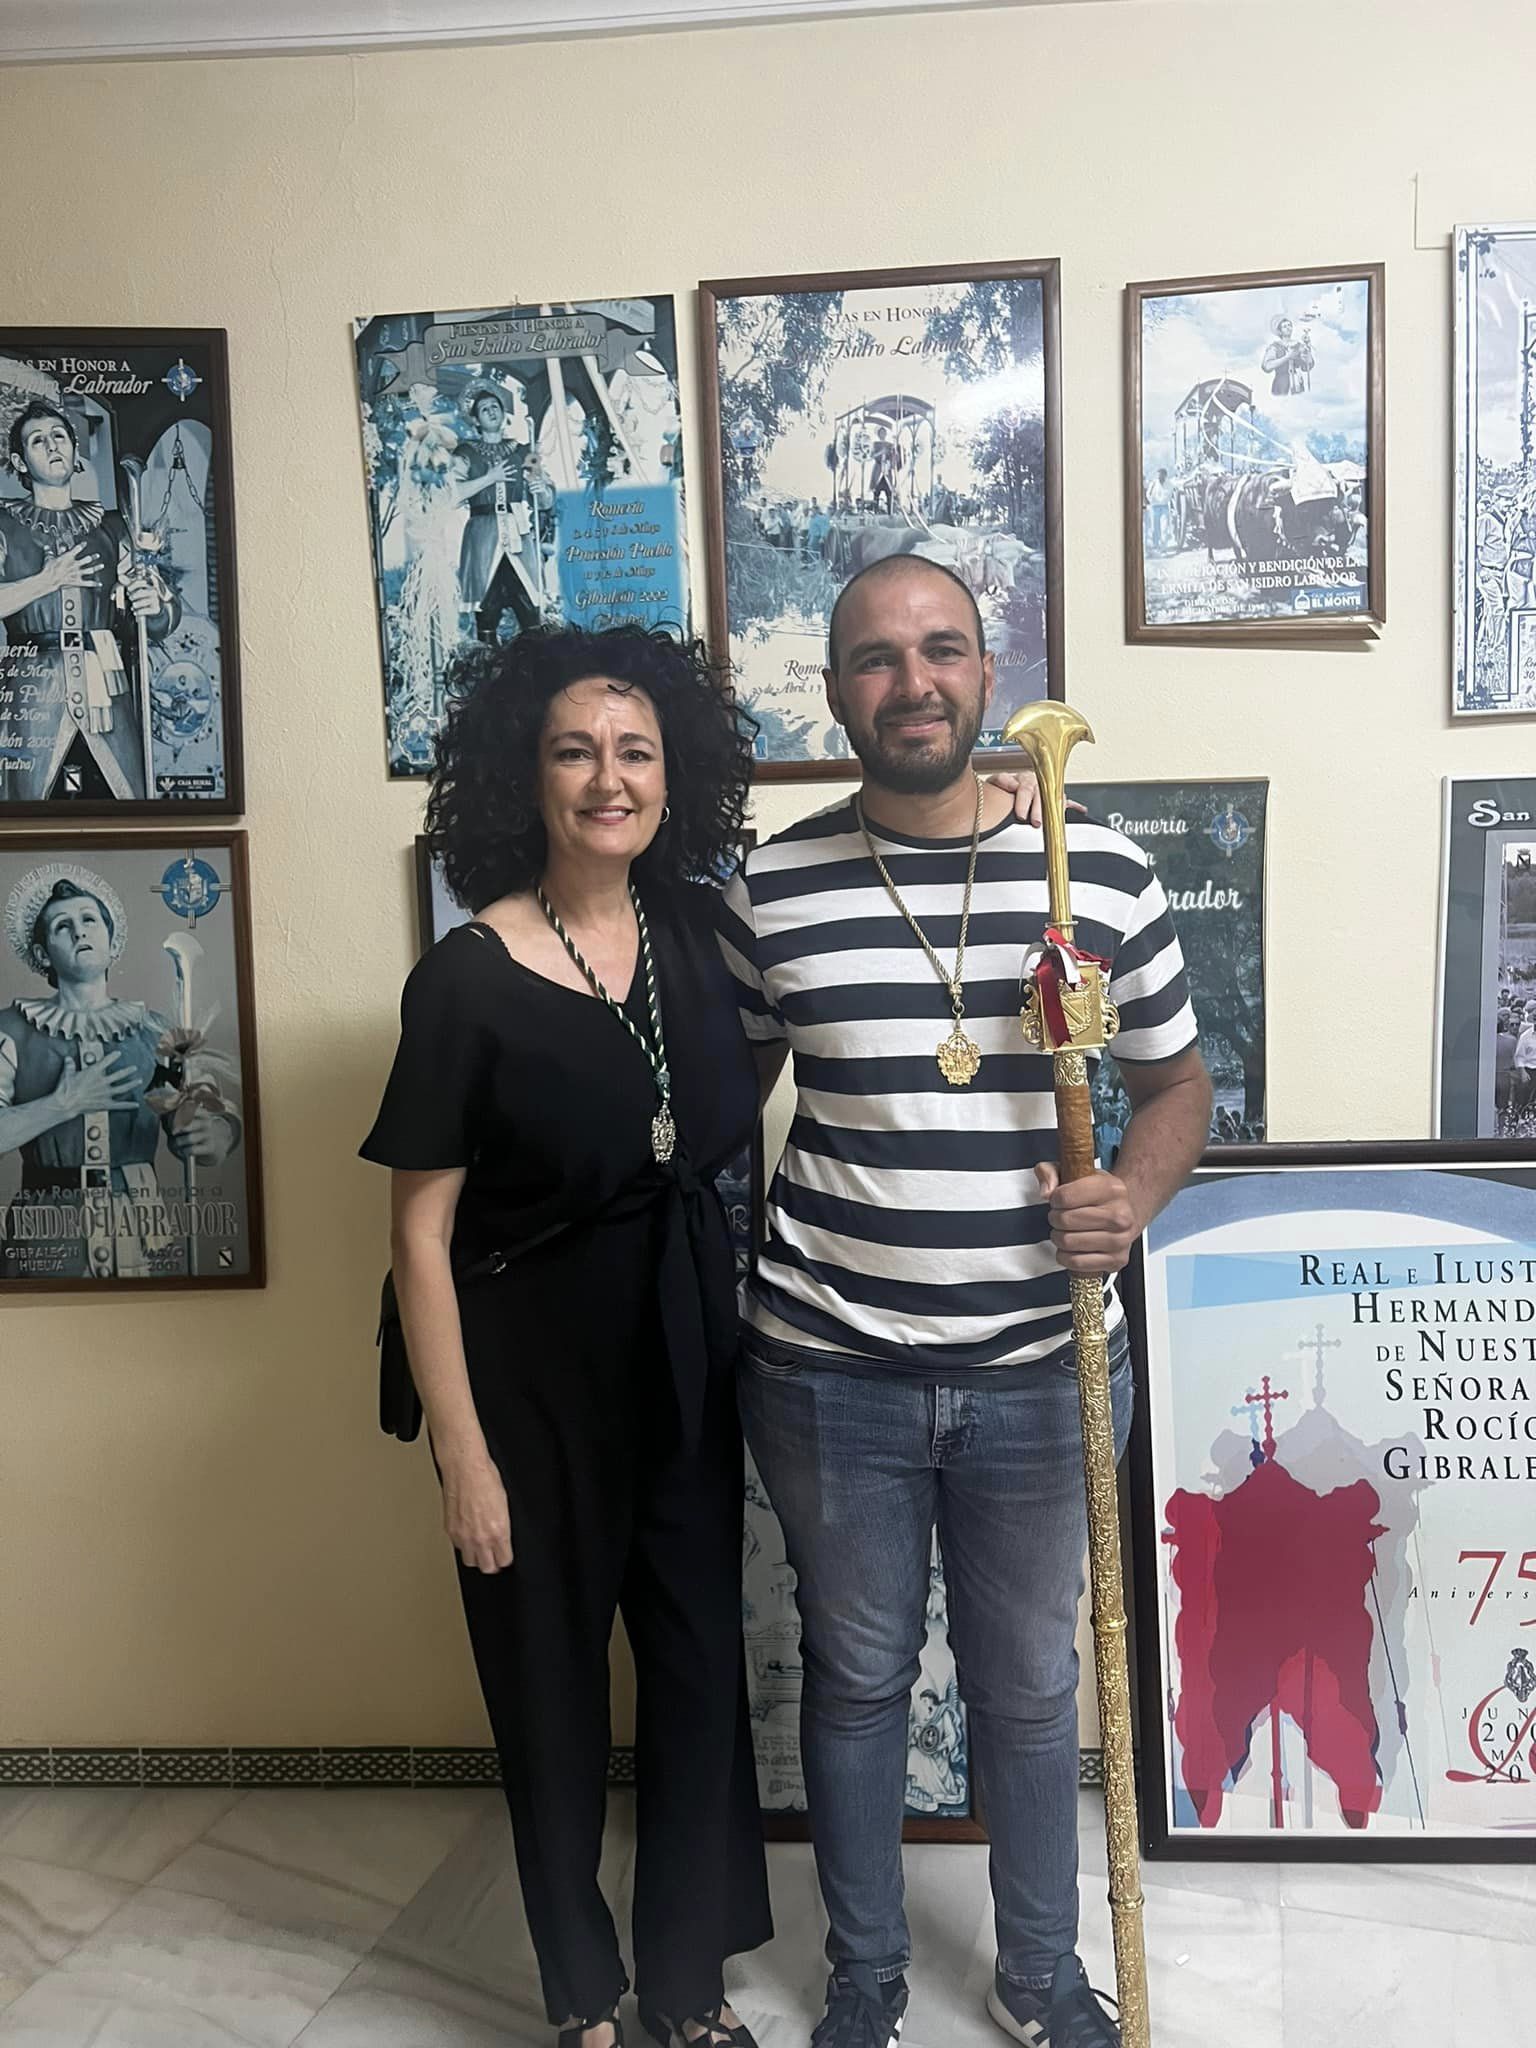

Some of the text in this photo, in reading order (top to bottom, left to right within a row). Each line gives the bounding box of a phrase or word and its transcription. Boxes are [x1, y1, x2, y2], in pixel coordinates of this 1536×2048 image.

[864, 309, 881, 321] EN
[887, 306, 941, 322] HONOR
[429, 330, 606, 363] San Isidro Labrador
[39, 359, 57, 371] EN
[61, 358, 117, 373] HONOR
[121, 360, 131, 372] A
[64, 374, 153, 395] Labrador
[1250, 561, 1258, 572] Y
[1259, 557, 1326, 573] BENDICIÓN
[1328, 556, 1343, 568] DE
[1209, 580, 1225, 592] DE
[1252, 574, 1292, 588] ISIDRO
[1295, 571, 1358, 587] LABRADOR
[1311, 595, 1361, 608] EL MONTE
[1467, 799, 1531, 828] San
[13, 1204, 96, 1241] ISIDRO
[103, 1201, 239, 1239] LABRADOR
[5, 1243, 81, 1259] GIBRALEÓN
[19, 1260, 65, 1273] HUELVA
[1300, 1253, 1390, 1286] REAL
[1433, 1252, 1536, 1284] ILUST
[1351, 1291, 1536, 1324] HERMAND
[1376, 1329, 1536, 1362] DE NUEST
[1385, 1368, 1530, 1401] SEÑORA
[1383, 1446, 1536, 1480] GIBRALE
[1408, 1586, 1530, 1600] Anivers
[1461, 1706, 1529, 1721] JUN
